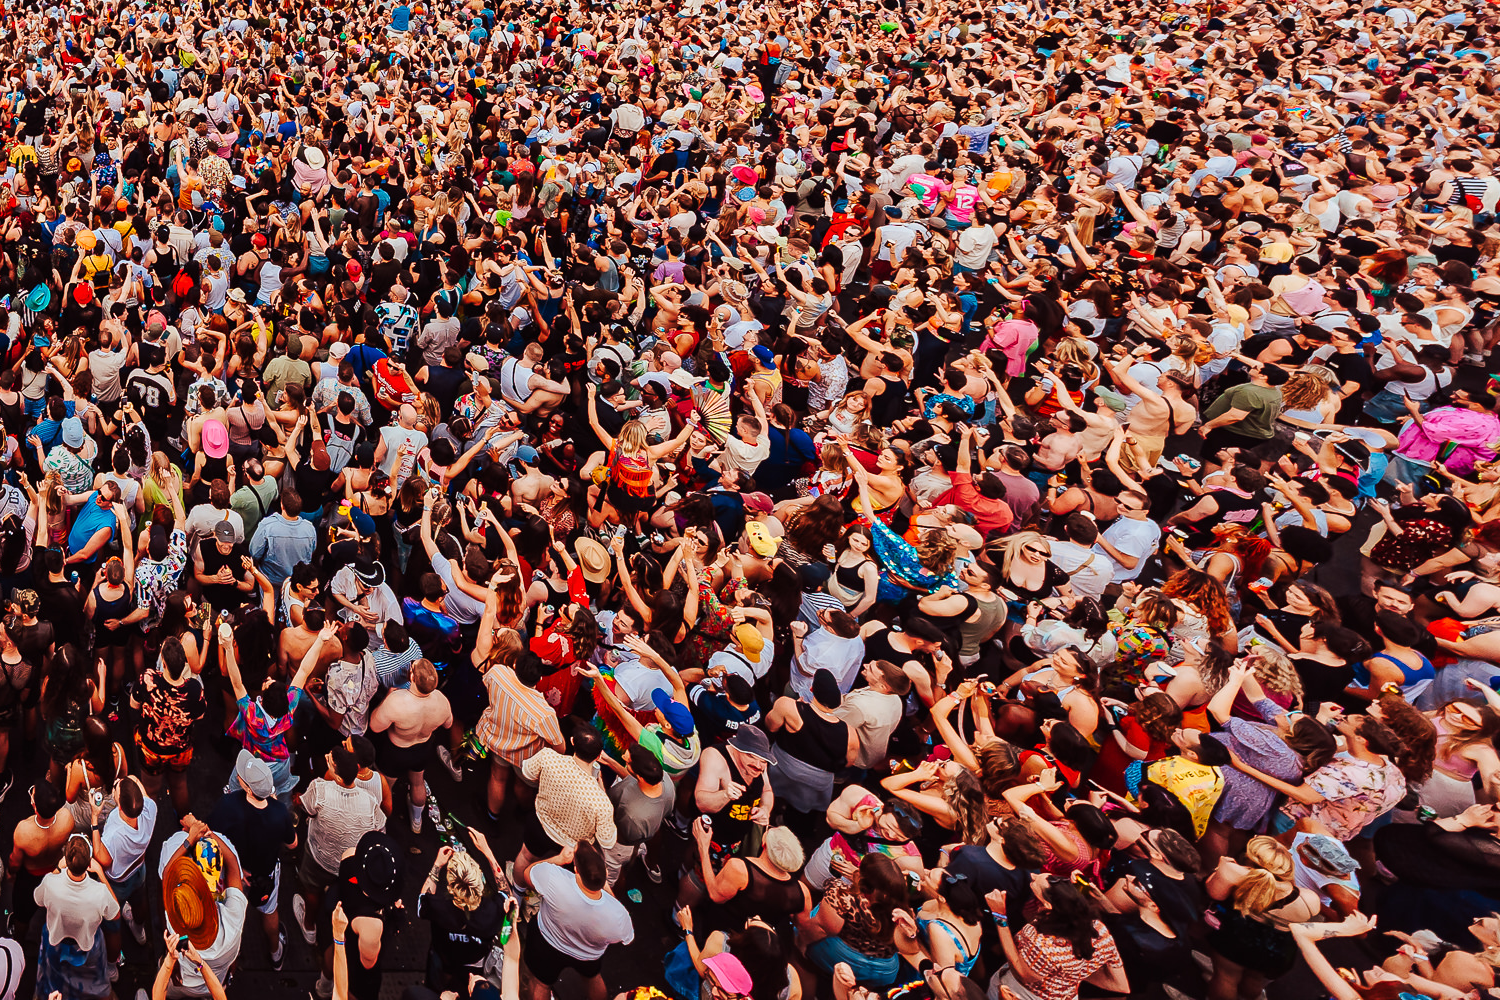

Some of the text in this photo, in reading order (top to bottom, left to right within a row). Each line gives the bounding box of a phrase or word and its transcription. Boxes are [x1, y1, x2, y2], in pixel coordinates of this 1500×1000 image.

[955, 195, 974, 209] 12
[132, 380, 161, 408] 78
[725, 720, 739, 730] RED
